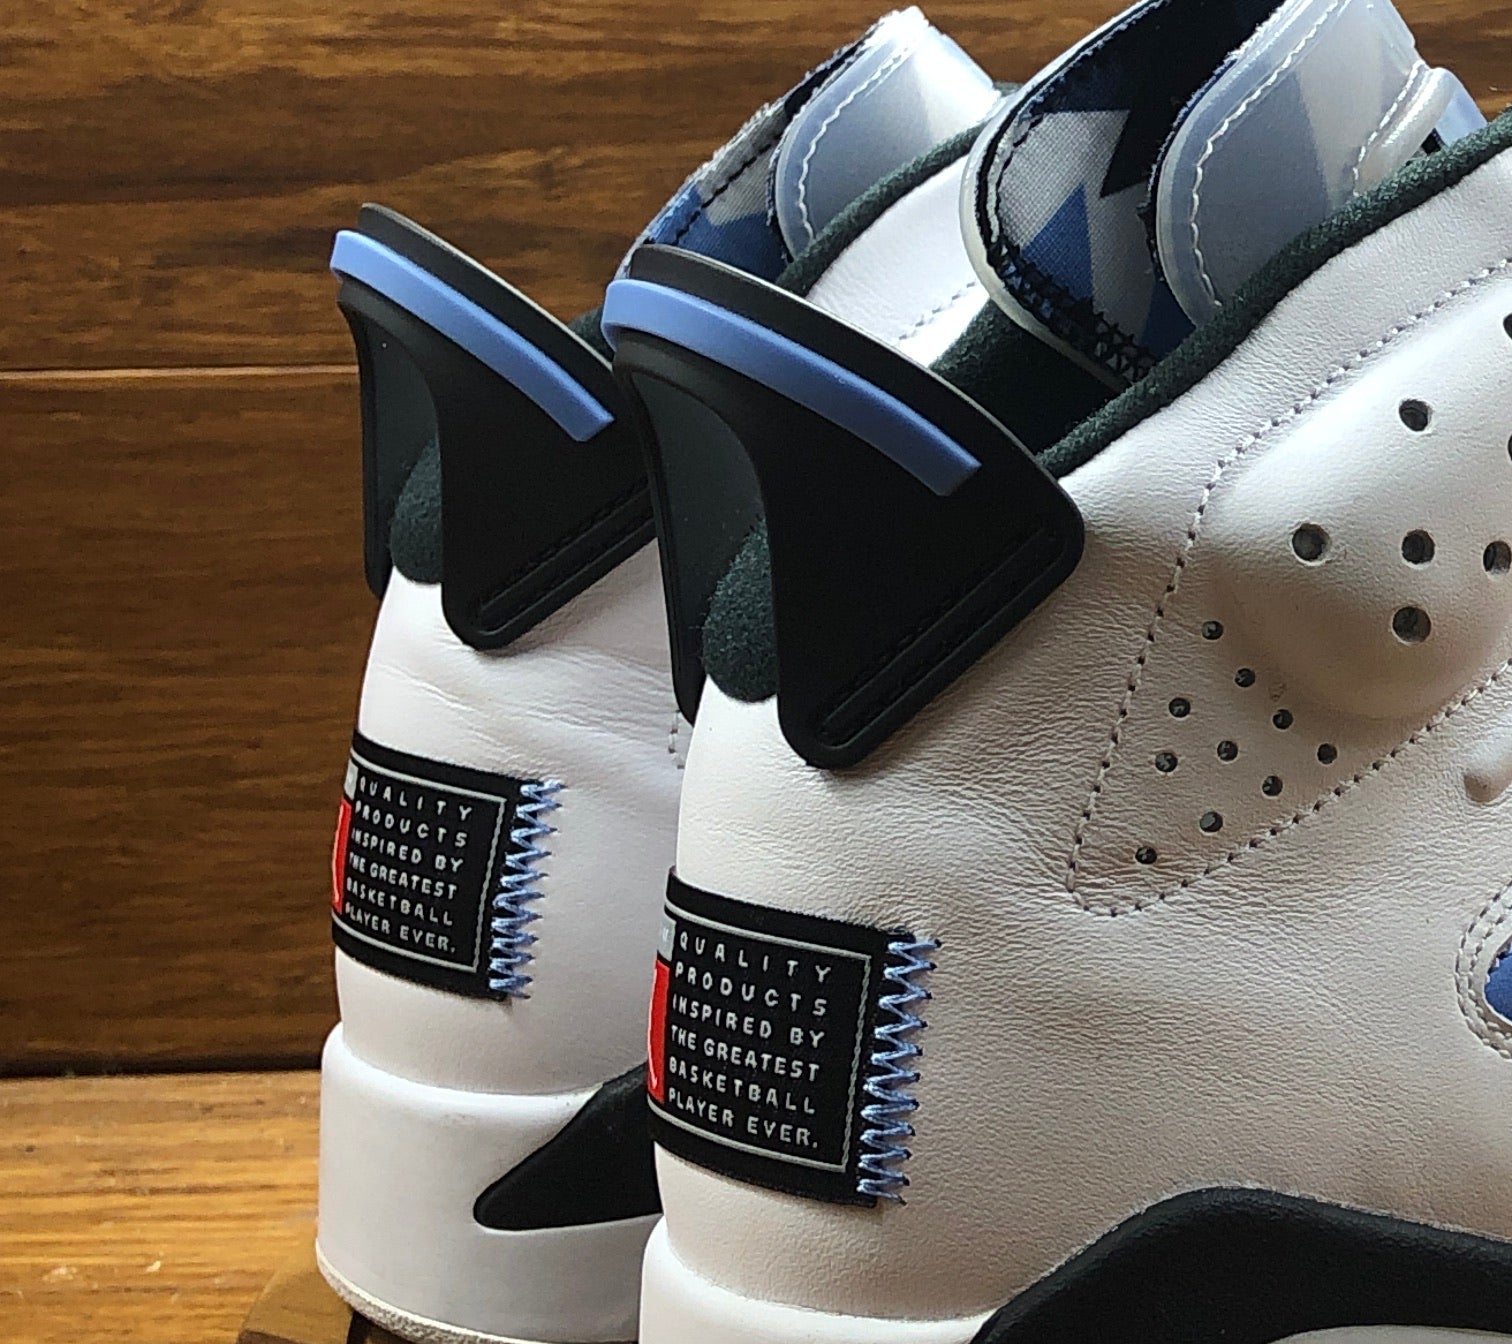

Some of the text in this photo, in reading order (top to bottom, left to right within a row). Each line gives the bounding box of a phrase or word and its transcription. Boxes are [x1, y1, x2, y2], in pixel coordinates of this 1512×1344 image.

[359, 775, 472, 821] QUALITY
[351, 827, 464, 872] INSPIRED BY
[355, 800, 468, 848] PRODUCTS
[349, 851, 458, 900] THE GREATEST
[346, 877, 453, 926] BASKETBALL
[345, 902, 456, 953] PLAYER EVER.
[679, 931, 831, 983] QUALITY
[674, 961, 828, 1017] PRODUCTS
[672, 993, 825, 1049] INSPIRED BY
[670, 1024, 820, 1082] THE GREATEST
[669, 1056, 816, 1115] BASKETBALL
[668, 1087, 819, 1148] PLAYER EVER.
